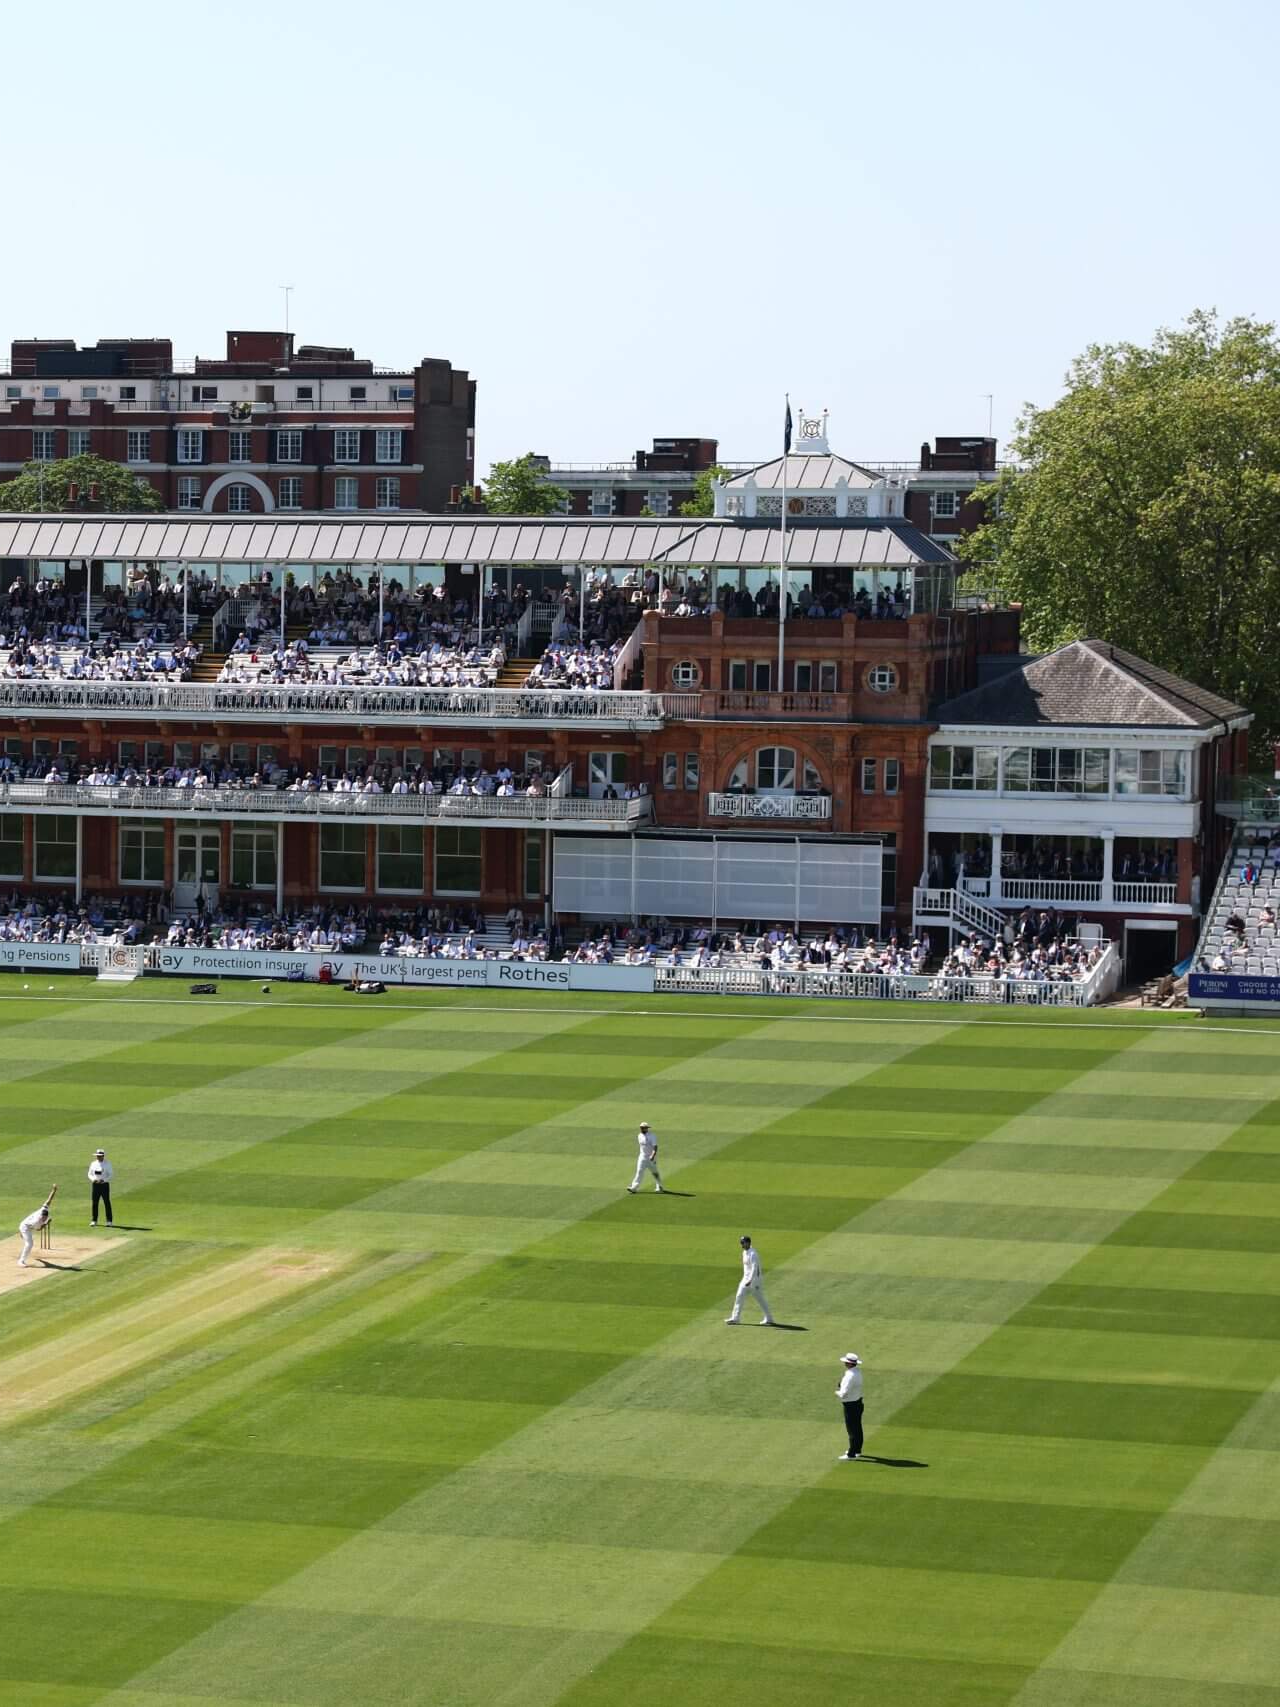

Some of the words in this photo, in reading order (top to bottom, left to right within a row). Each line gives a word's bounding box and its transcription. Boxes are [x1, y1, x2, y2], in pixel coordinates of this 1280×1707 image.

[18, 949, 71, 962] Pensions
[162, 955, 184, 970] ay
[265, 959, 308, 971] insurer
[353, 962, 376, 974] The
[380, 963, 407, 976] UK's
[411, 965, 453, 979] largest
[499, 965, 568, 983] Rothes
